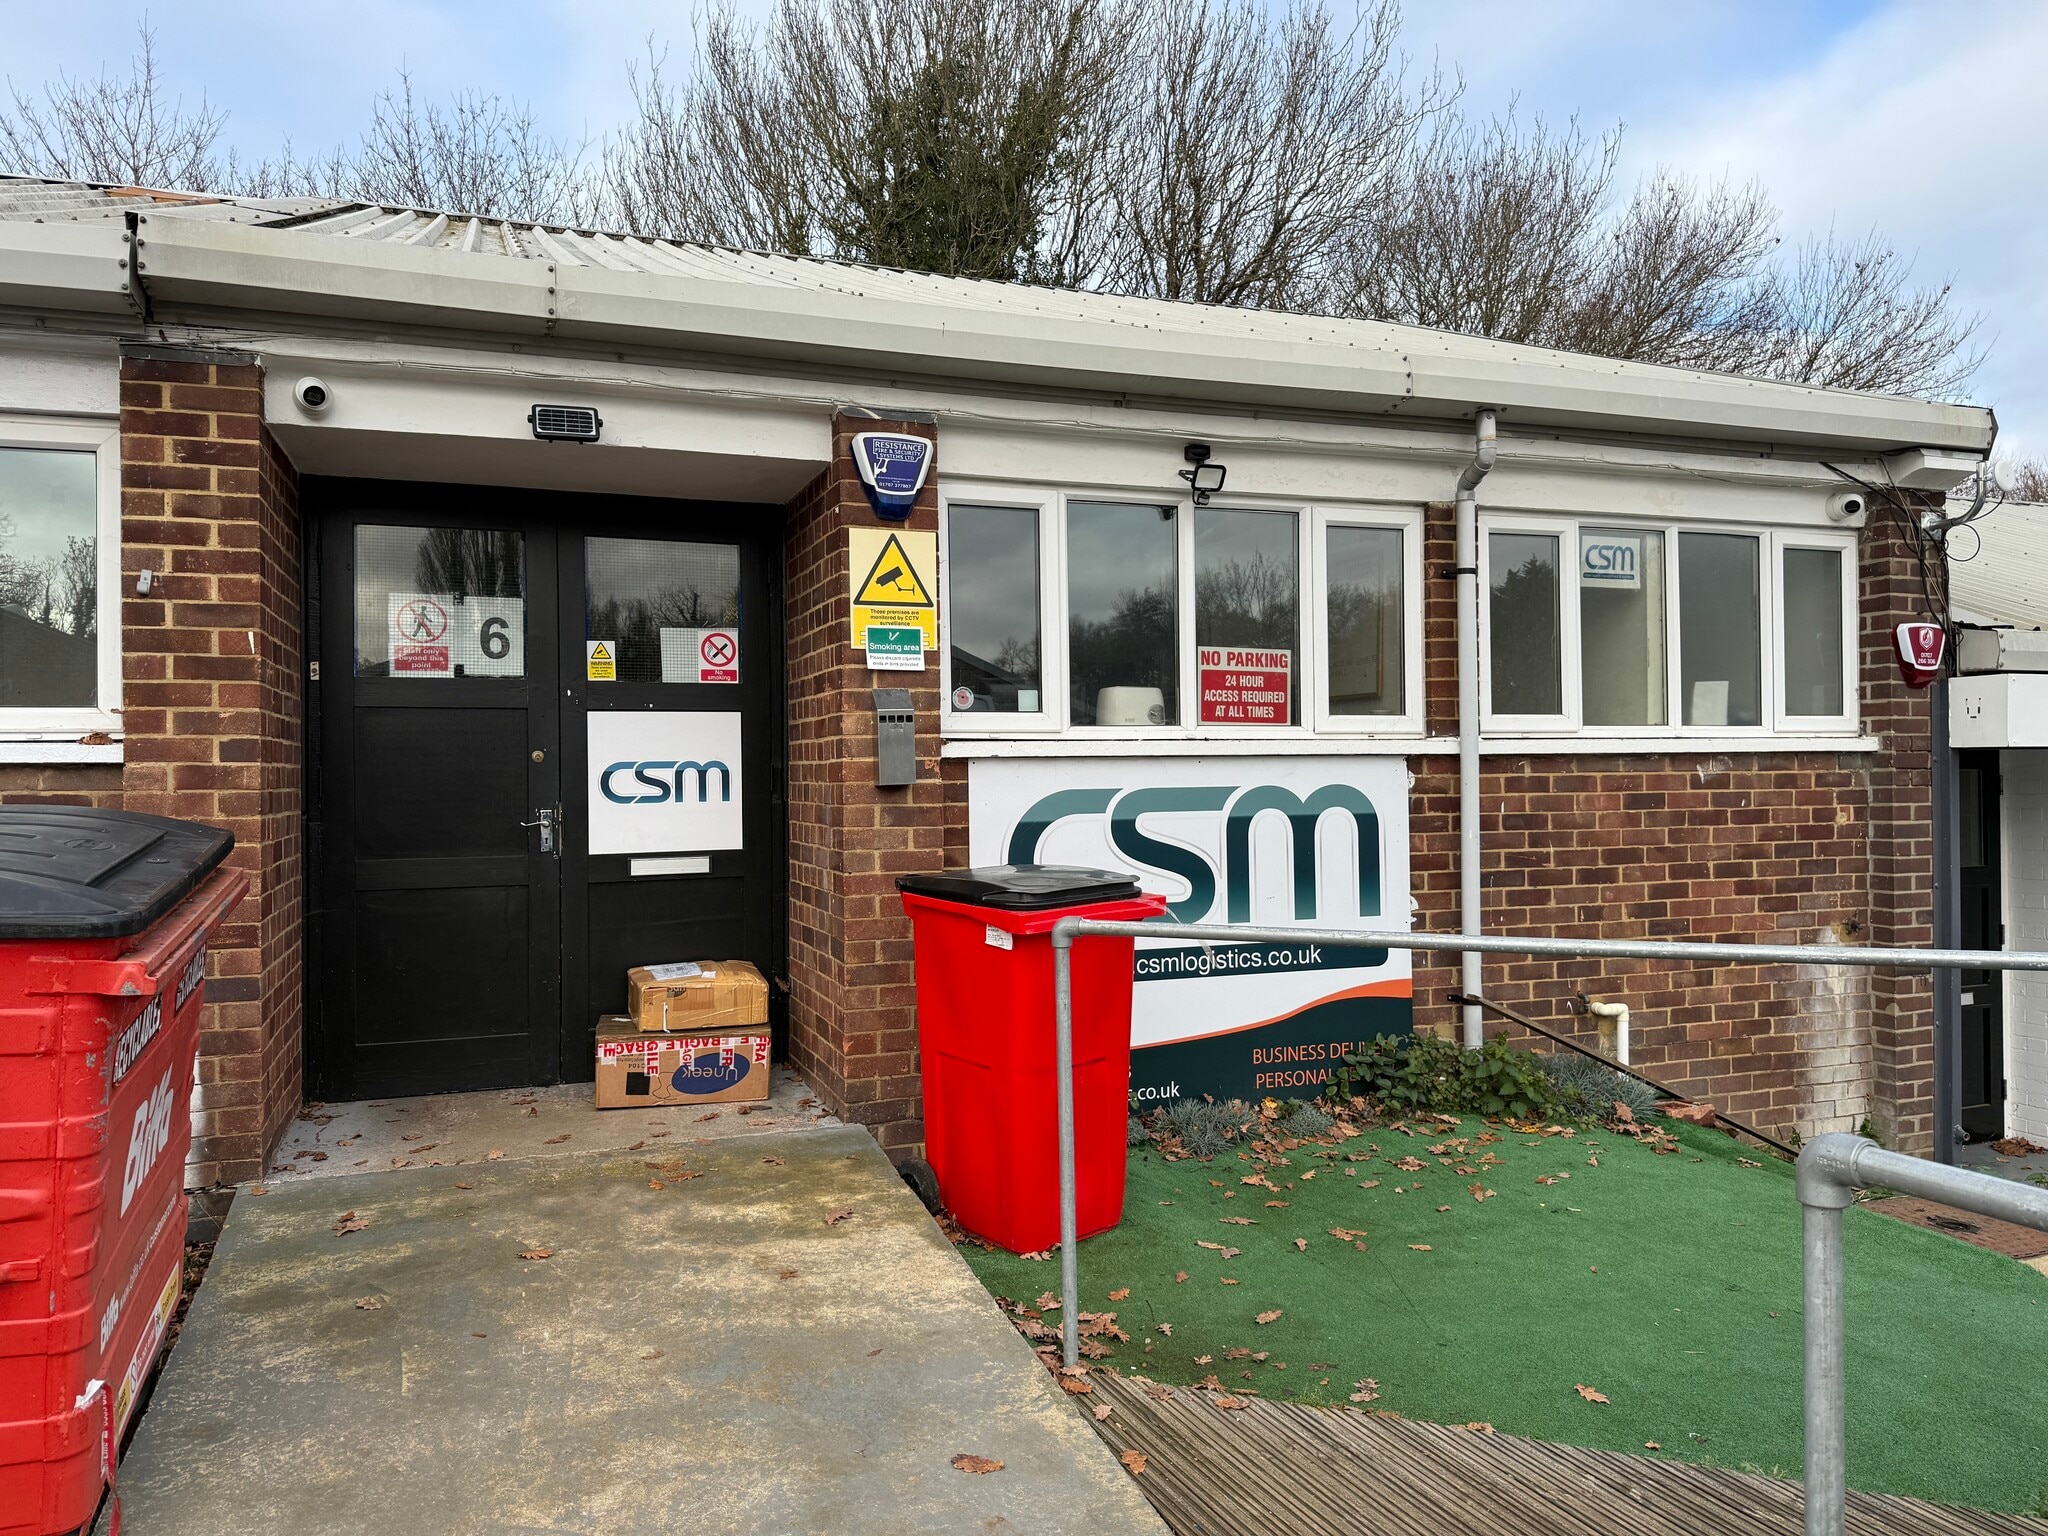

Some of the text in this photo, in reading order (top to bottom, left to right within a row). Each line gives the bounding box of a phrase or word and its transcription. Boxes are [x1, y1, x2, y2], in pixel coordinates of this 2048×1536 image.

[875, 441, 922, 452] RESISTANCE
[480, 617, 510, 660] 6
[869, 643, 902, 652] Smoking
[399, 654, 428, 662] beyond
[1201, 651, 1288, 668] NO PARKING
[1225, 675, 1264, 687] 24 HOUR
[1204, 690, 1285, 704] ACCESS REQUIRED
[1215, 705, 1274, 718] AT ALL TIMES
[1253, 1043, 1326, 1065] BUSINESS
[682, 1067, 738, 1081] Uneek
[120, 1062, 174, 1218] Biffa
[100, 1291, 119, 1355] Biffa
